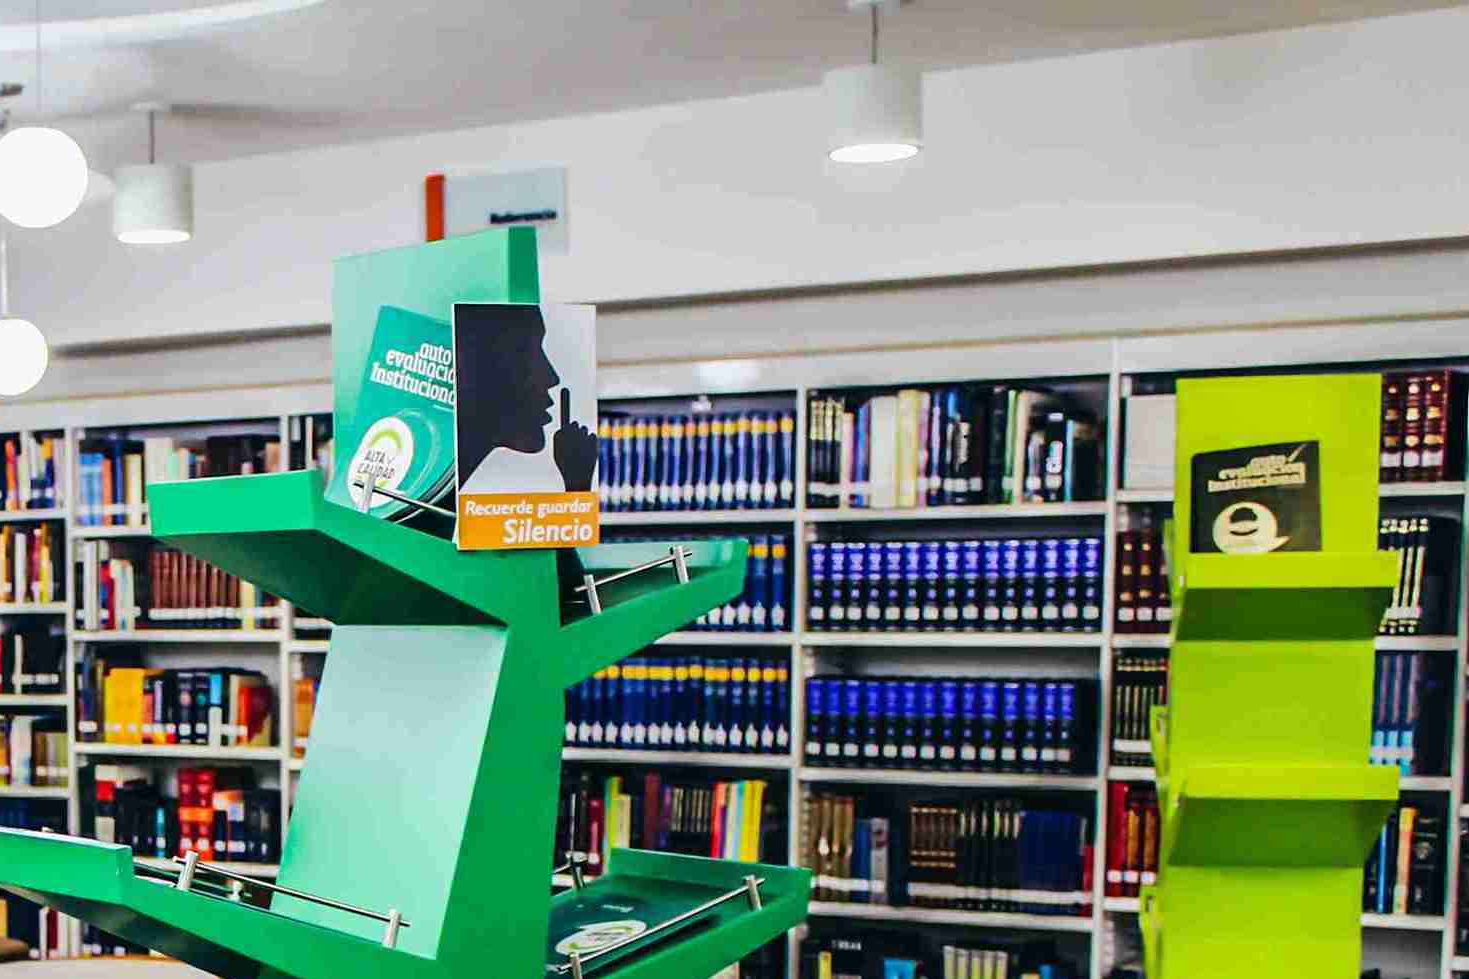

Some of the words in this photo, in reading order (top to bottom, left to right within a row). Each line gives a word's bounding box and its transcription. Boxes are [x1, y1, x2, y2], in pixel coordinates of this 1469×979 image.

[420, 343, 452, 366] auto
[537, 498, 593, 518] guardar
[503, 518, 593, 543] Silencio
